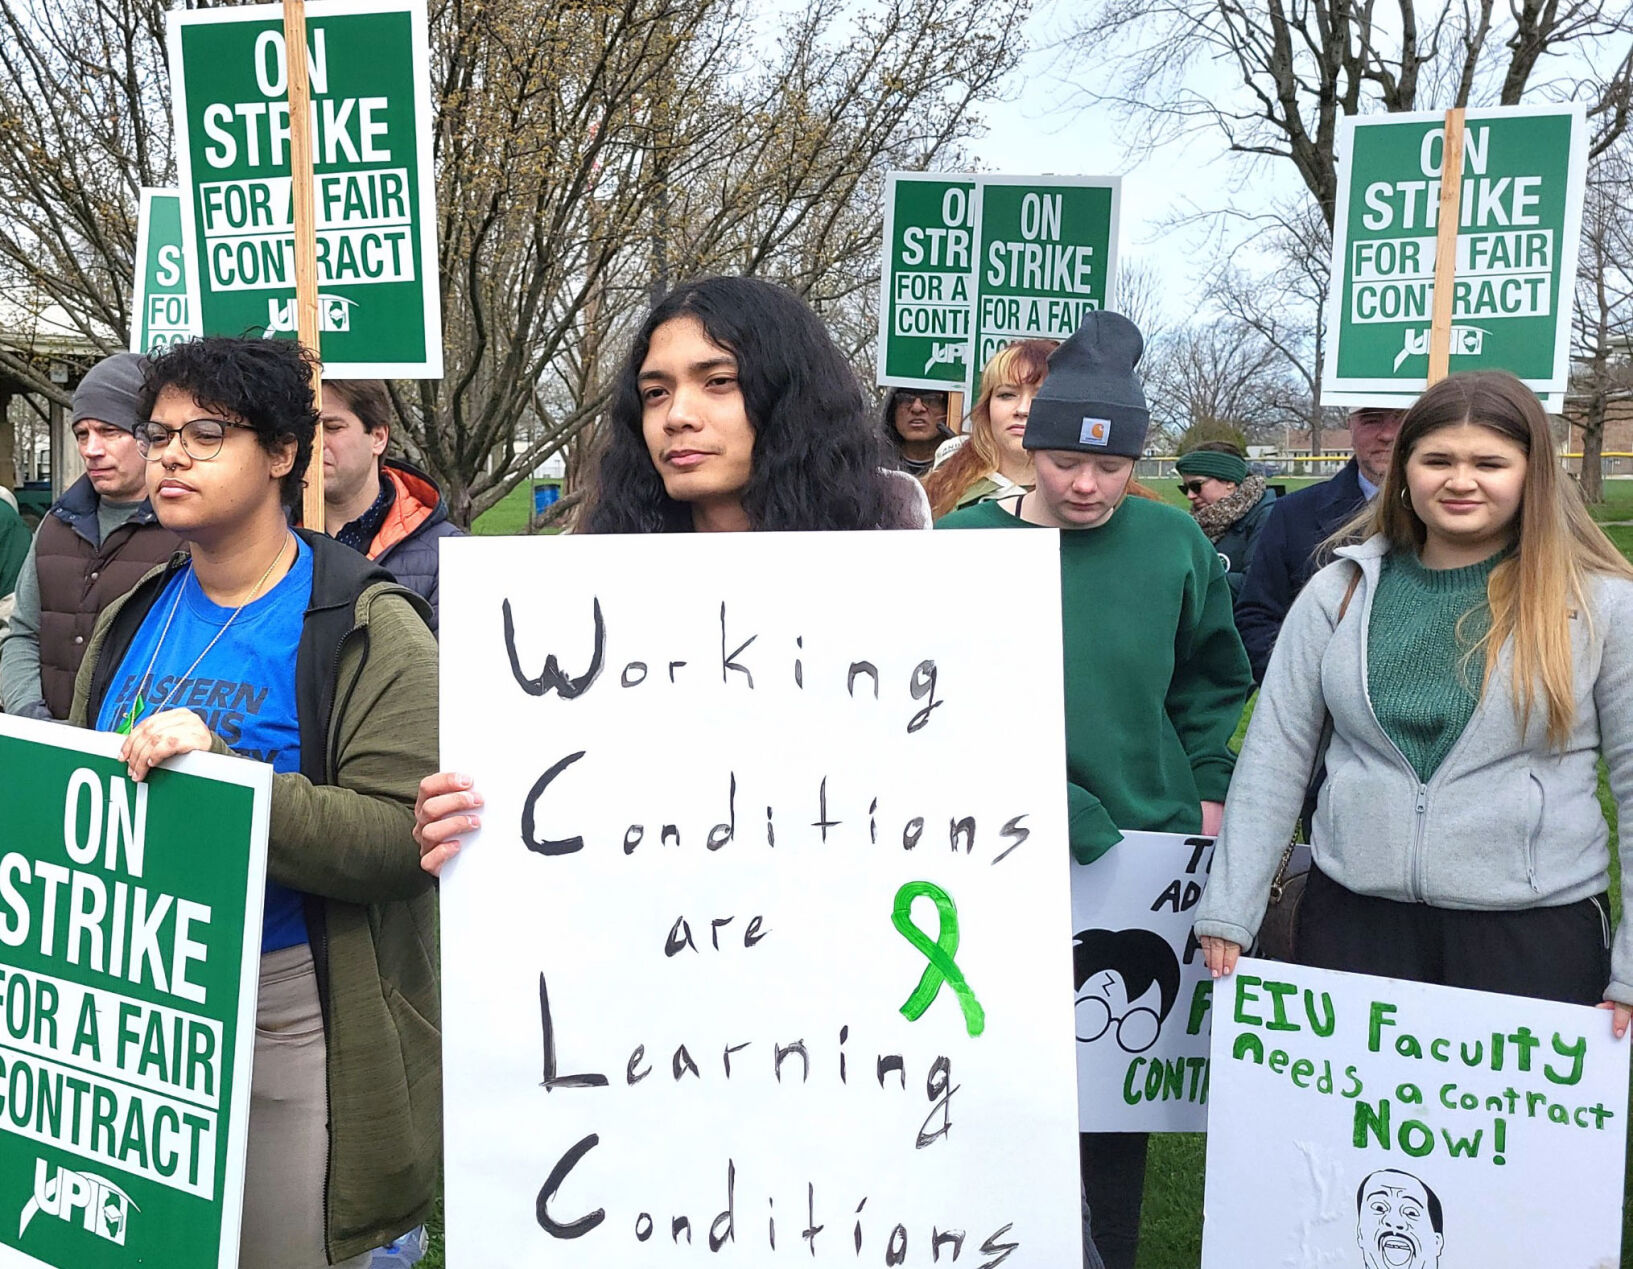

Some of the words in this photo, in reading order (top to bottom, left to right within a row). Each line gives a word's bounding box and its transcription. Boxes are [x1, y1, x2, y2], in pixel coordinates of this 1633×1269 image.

[1420, 126, 1490, 177] ON
[203, 183, 273, 229] FOR
[322, 173, 406, 222] FAIR
[1021, 193, 1062, 241] ON
[902, 227, 973, 267] STR
[987, 240, 1093, 294] STRIKE
[1355, 241, 1420, 276] FOR
[1469, 233, 1548, 270] FAIR
[897, 275, 942, 300] FOR
[951, 276, 968, 300] A
[982, 298, 1020, 331] FOR
[1026, 300, 1041, 331] A
[1356, 278, 1545, 319] CONRACT
[503, 594, 943, 733] Working
[115, 673, 268, 715] EASTERN
[64, 767, 148, 878] ON
[521, 750, 1031, 866] Conditions
[0, 851, 211, 1004] STRIKE
[664, 914, 773, 958] are
[0, 970, 58, 1050] OR
[72, 992, 101, 1062] A
[117, 1001, 216, 1097] FAIR
[1234, 974, 1335, 1037] EIU
[1368, 1001, 1586, 1086] Faculty
[539, 970, 961, 1149] Learning
[1232, 1032, 1363, 1099] needs
[1395, 1083, 1423, 1104] a
[1439, 1083, 1614, 1130] contract
[535, 1132, 1020, 1269] Conditions
